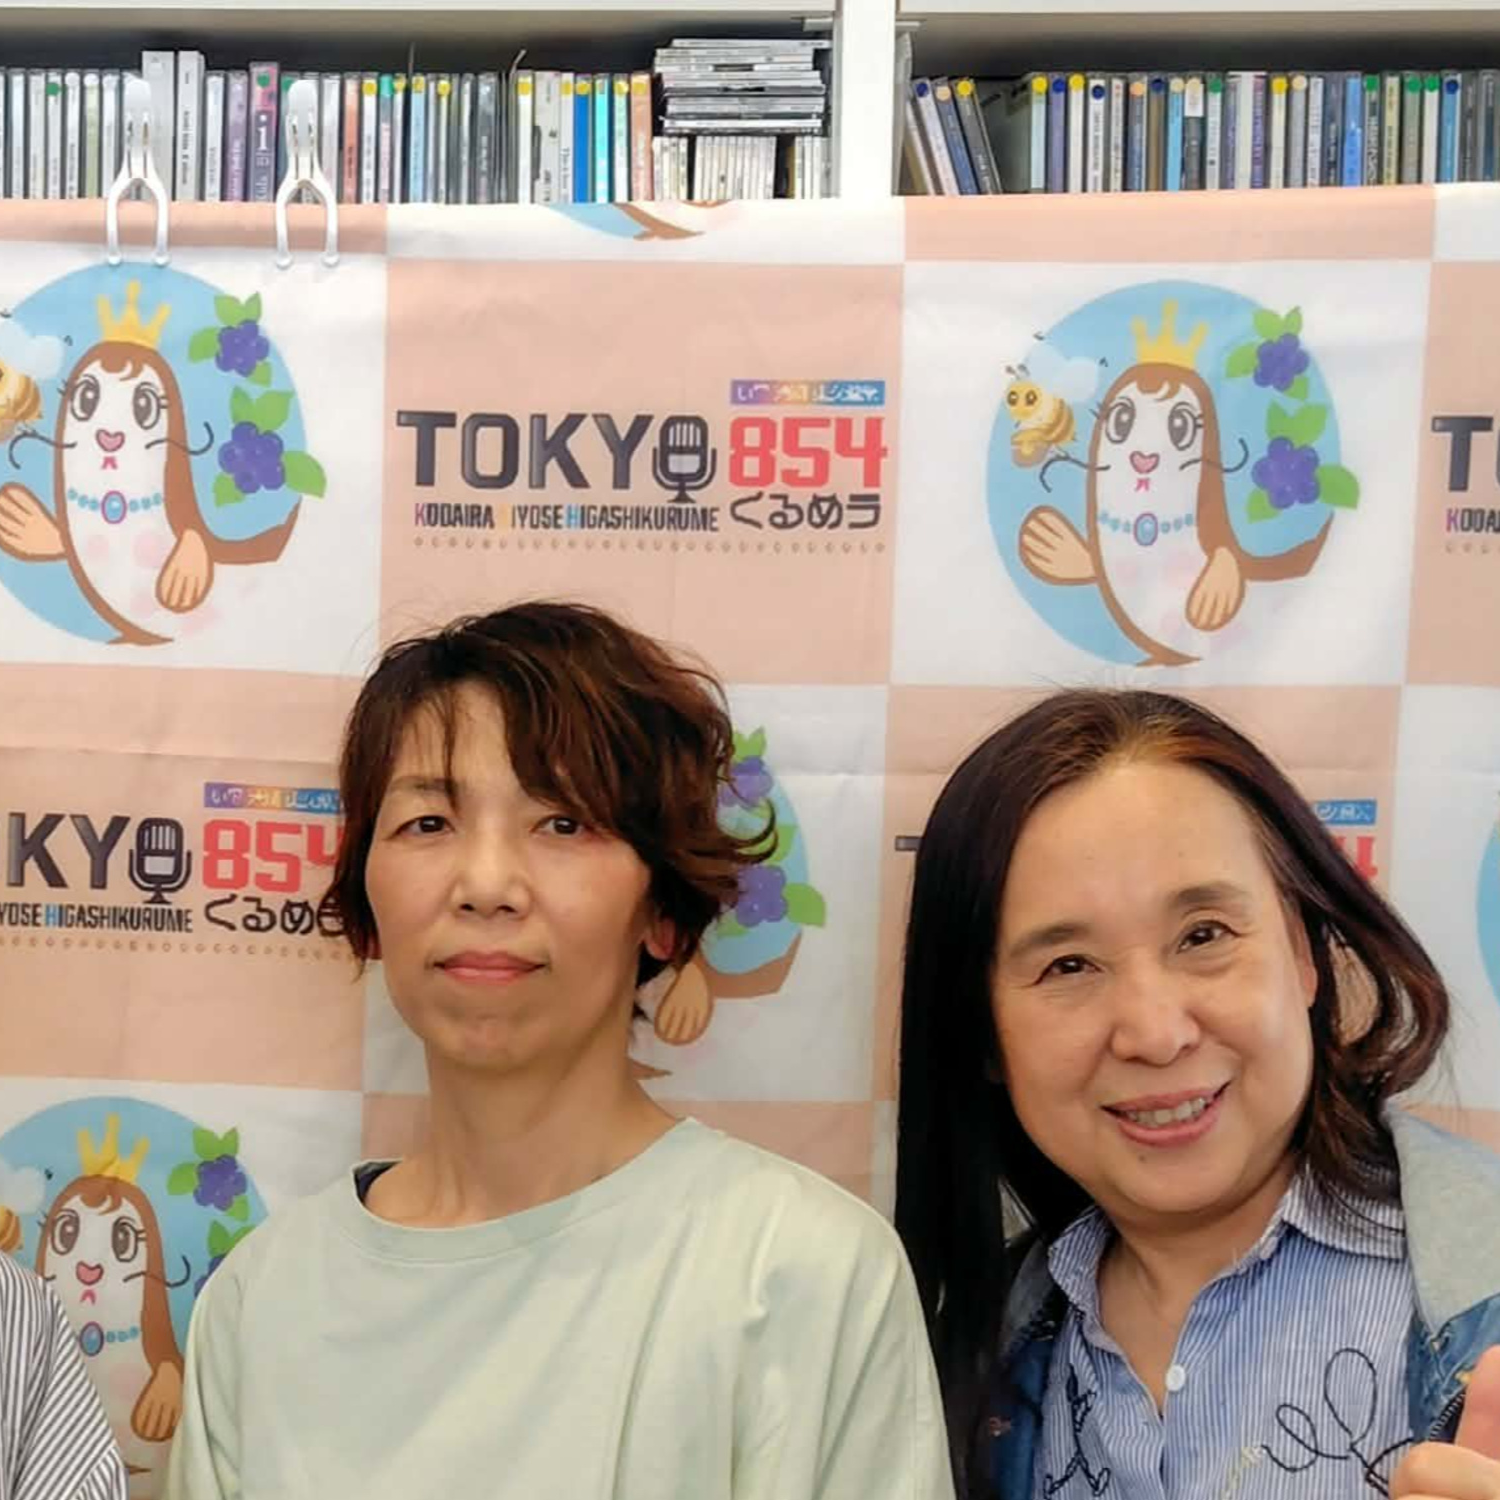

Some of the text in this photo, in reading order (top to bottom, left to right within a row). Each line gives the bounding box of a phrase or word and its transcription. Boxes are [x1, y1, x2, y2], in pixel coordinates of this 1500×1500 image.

[729, 416, 888, 488] 854
[415, 503, 495, 529] KODAIRA
[566, 503, 719, 531] HIGASHIKURUME
[45, 903, 193, 933] HIGASHIKURUME
